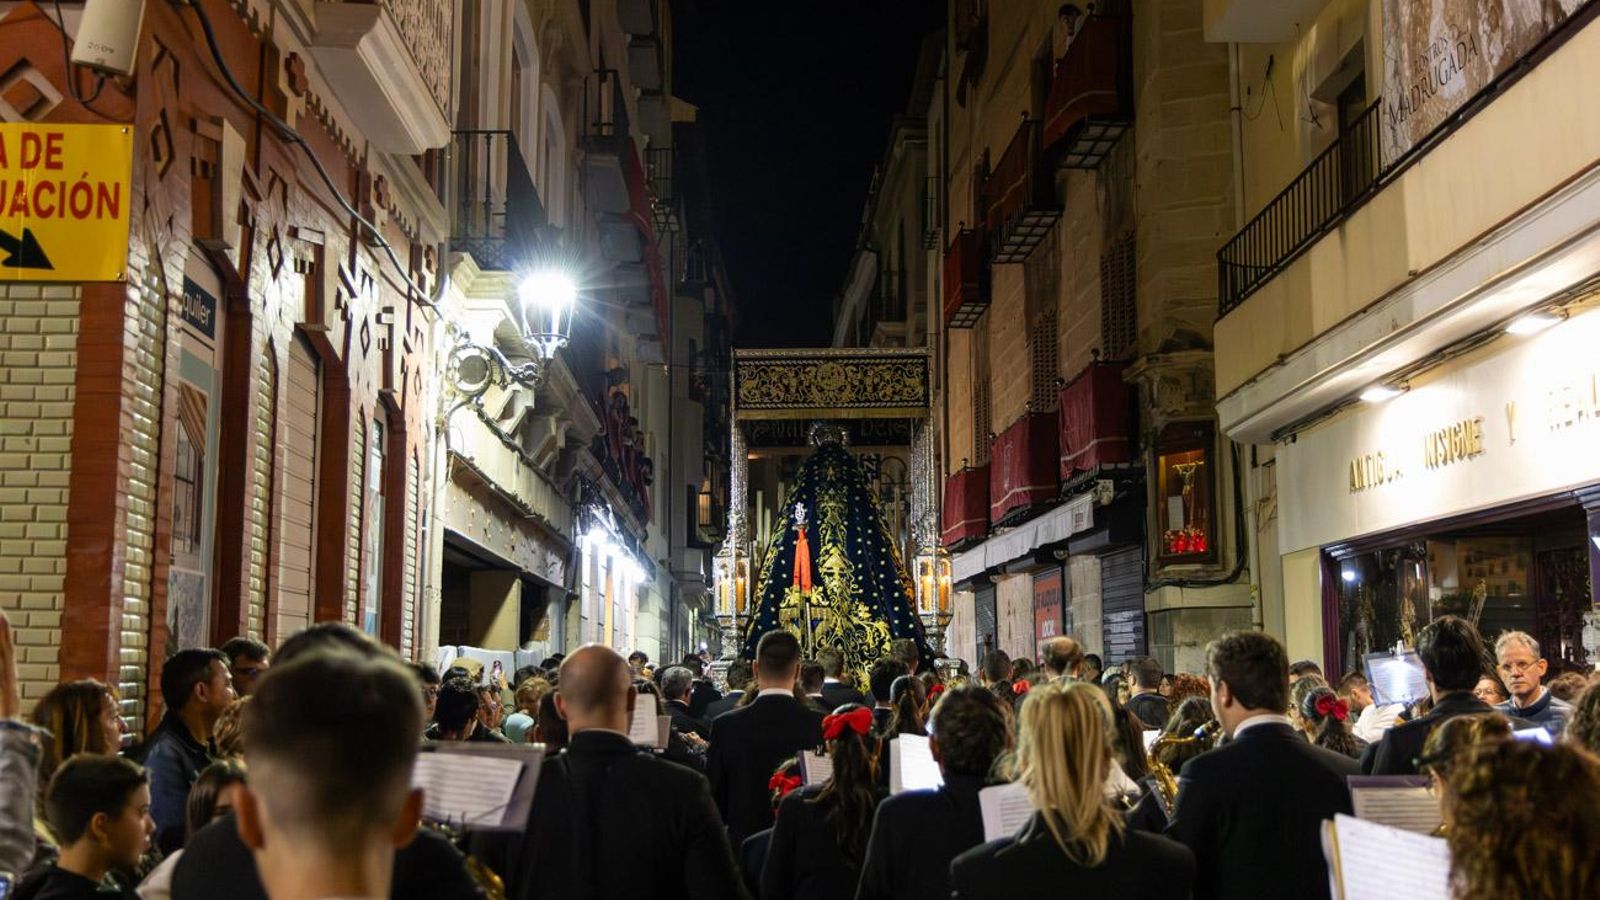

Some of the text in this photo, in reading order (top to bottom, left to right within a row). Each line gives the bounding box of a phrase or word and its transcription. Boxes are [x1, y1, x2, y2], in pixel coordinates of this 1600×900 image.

[1387, 33, 1478, 123] MADRUGADA
[20, 131, 64, 170] DE
[1349, 449, 1404, 494] ANTIG
[1424, 416, 1484, 470] INSIGNE
[1505, 400, 1517, 446] Y
